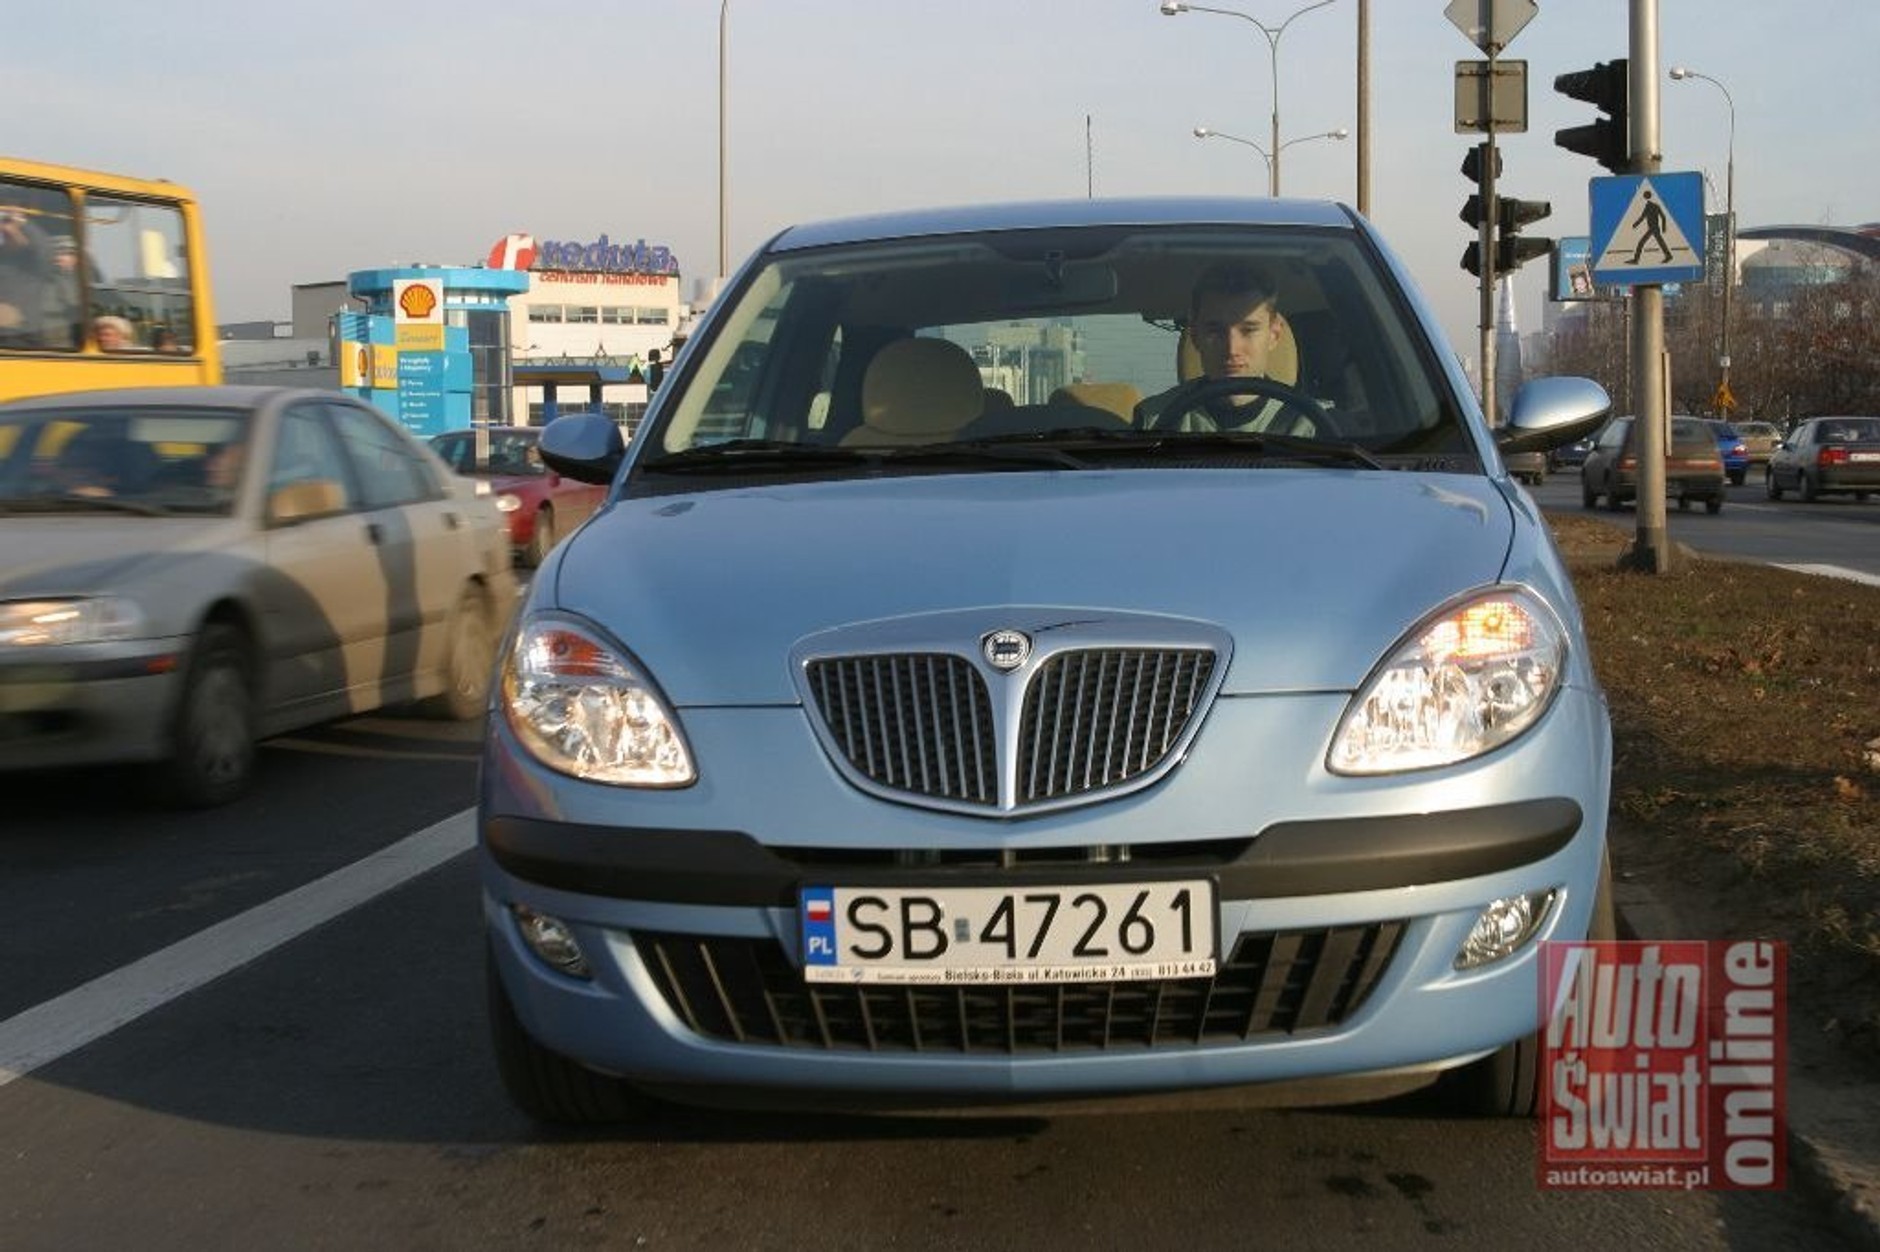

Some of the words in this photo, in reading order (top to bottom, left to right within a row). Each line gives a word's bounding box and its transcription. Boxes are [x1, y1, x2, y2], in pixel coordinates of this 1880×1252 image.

[541, 233, 676, 269] reduta
[602, 273, 668, 286] handlowe
[846, 896, 949, 960] SB
[979, 889, 1192, 959] 47261
[808, 937, 833, 955] PL
[1045, 967, 1106, 979] Katowicka
[1111, 966, 1125, 977] 24
